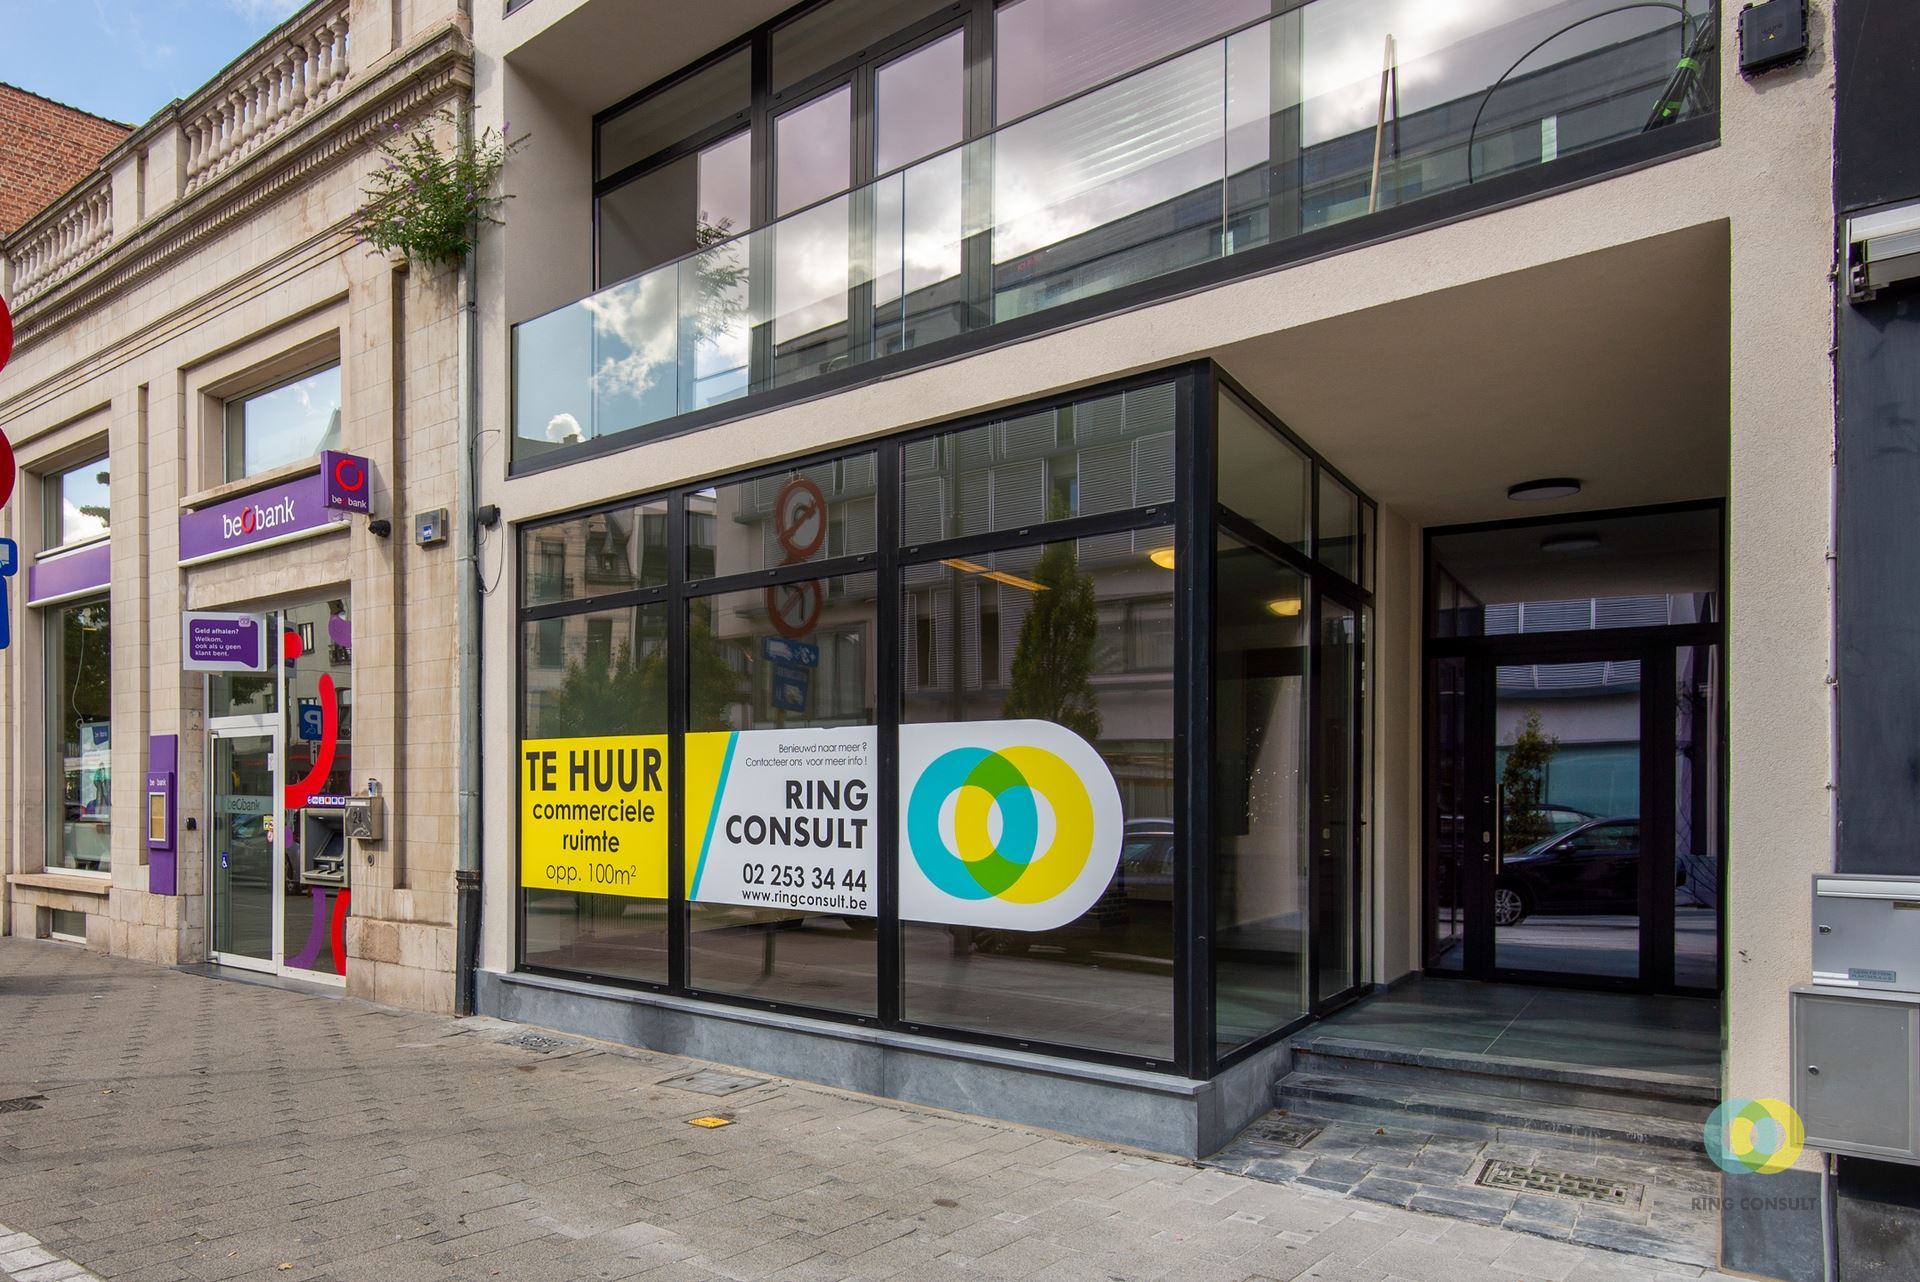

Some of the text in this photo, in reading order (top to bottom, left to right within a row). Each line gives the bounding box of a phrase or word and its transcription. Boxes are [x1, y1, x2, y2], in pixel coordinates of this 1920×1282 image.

[778, 741, 868, 754] Benieuwd naar meer ?
[526, 748, 663, 793] TE HUUR
[745, 757, 788, 768] Contacteer
[789, 757, 803, 767] ons
[805, 758, 824, 766] voor
[824, 757, 847, 766] meer
[847, 755, 864, 766] info
[785, 779, 869, 812] RING
[532, 798, 655, 822] commerciele
[563, 828, 620, 853] ruimte
[725, 814, 868, 849] CONSULT
[545, 864, 582, 885] opp.
[742, 862, 868, 893] 02 253 34 44
[741, 889, 868, 911] www.ringconsult.be
